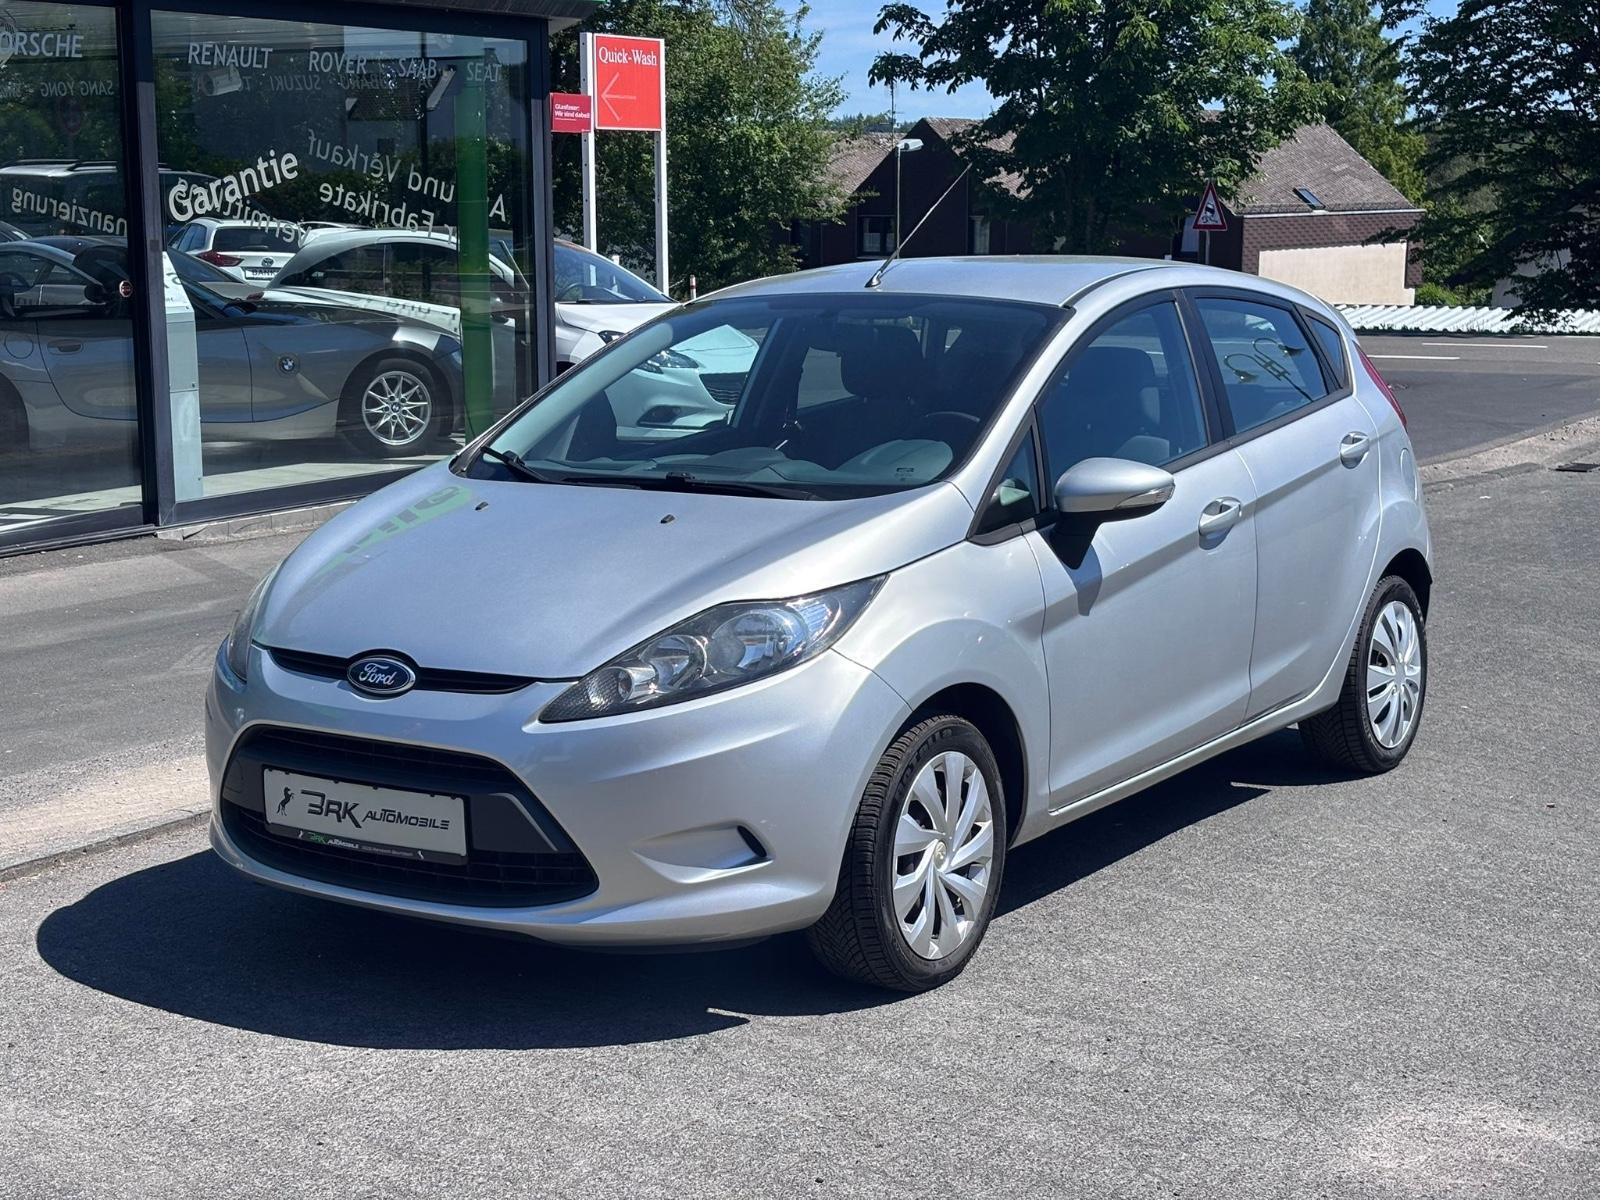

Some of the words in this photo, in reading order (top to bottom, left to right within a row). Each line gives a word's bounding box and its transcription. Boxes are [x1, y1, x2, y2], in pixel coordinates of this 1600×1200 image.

[188, 43, 273, 69] RENAULT
[308, 51, 367, 74] ROVER
[398, 57, 437, 79] SAAB
[466, 62, 501, 82] SEAT
[598, 46, 658, 66] Quick-Wash
[168, 149, 299, 222] Garantie
[359, 662, 397, 685] Ford
[301, 789, 362, 828] BRK
[362, 809, 450, 830] AUTOMOBILE
